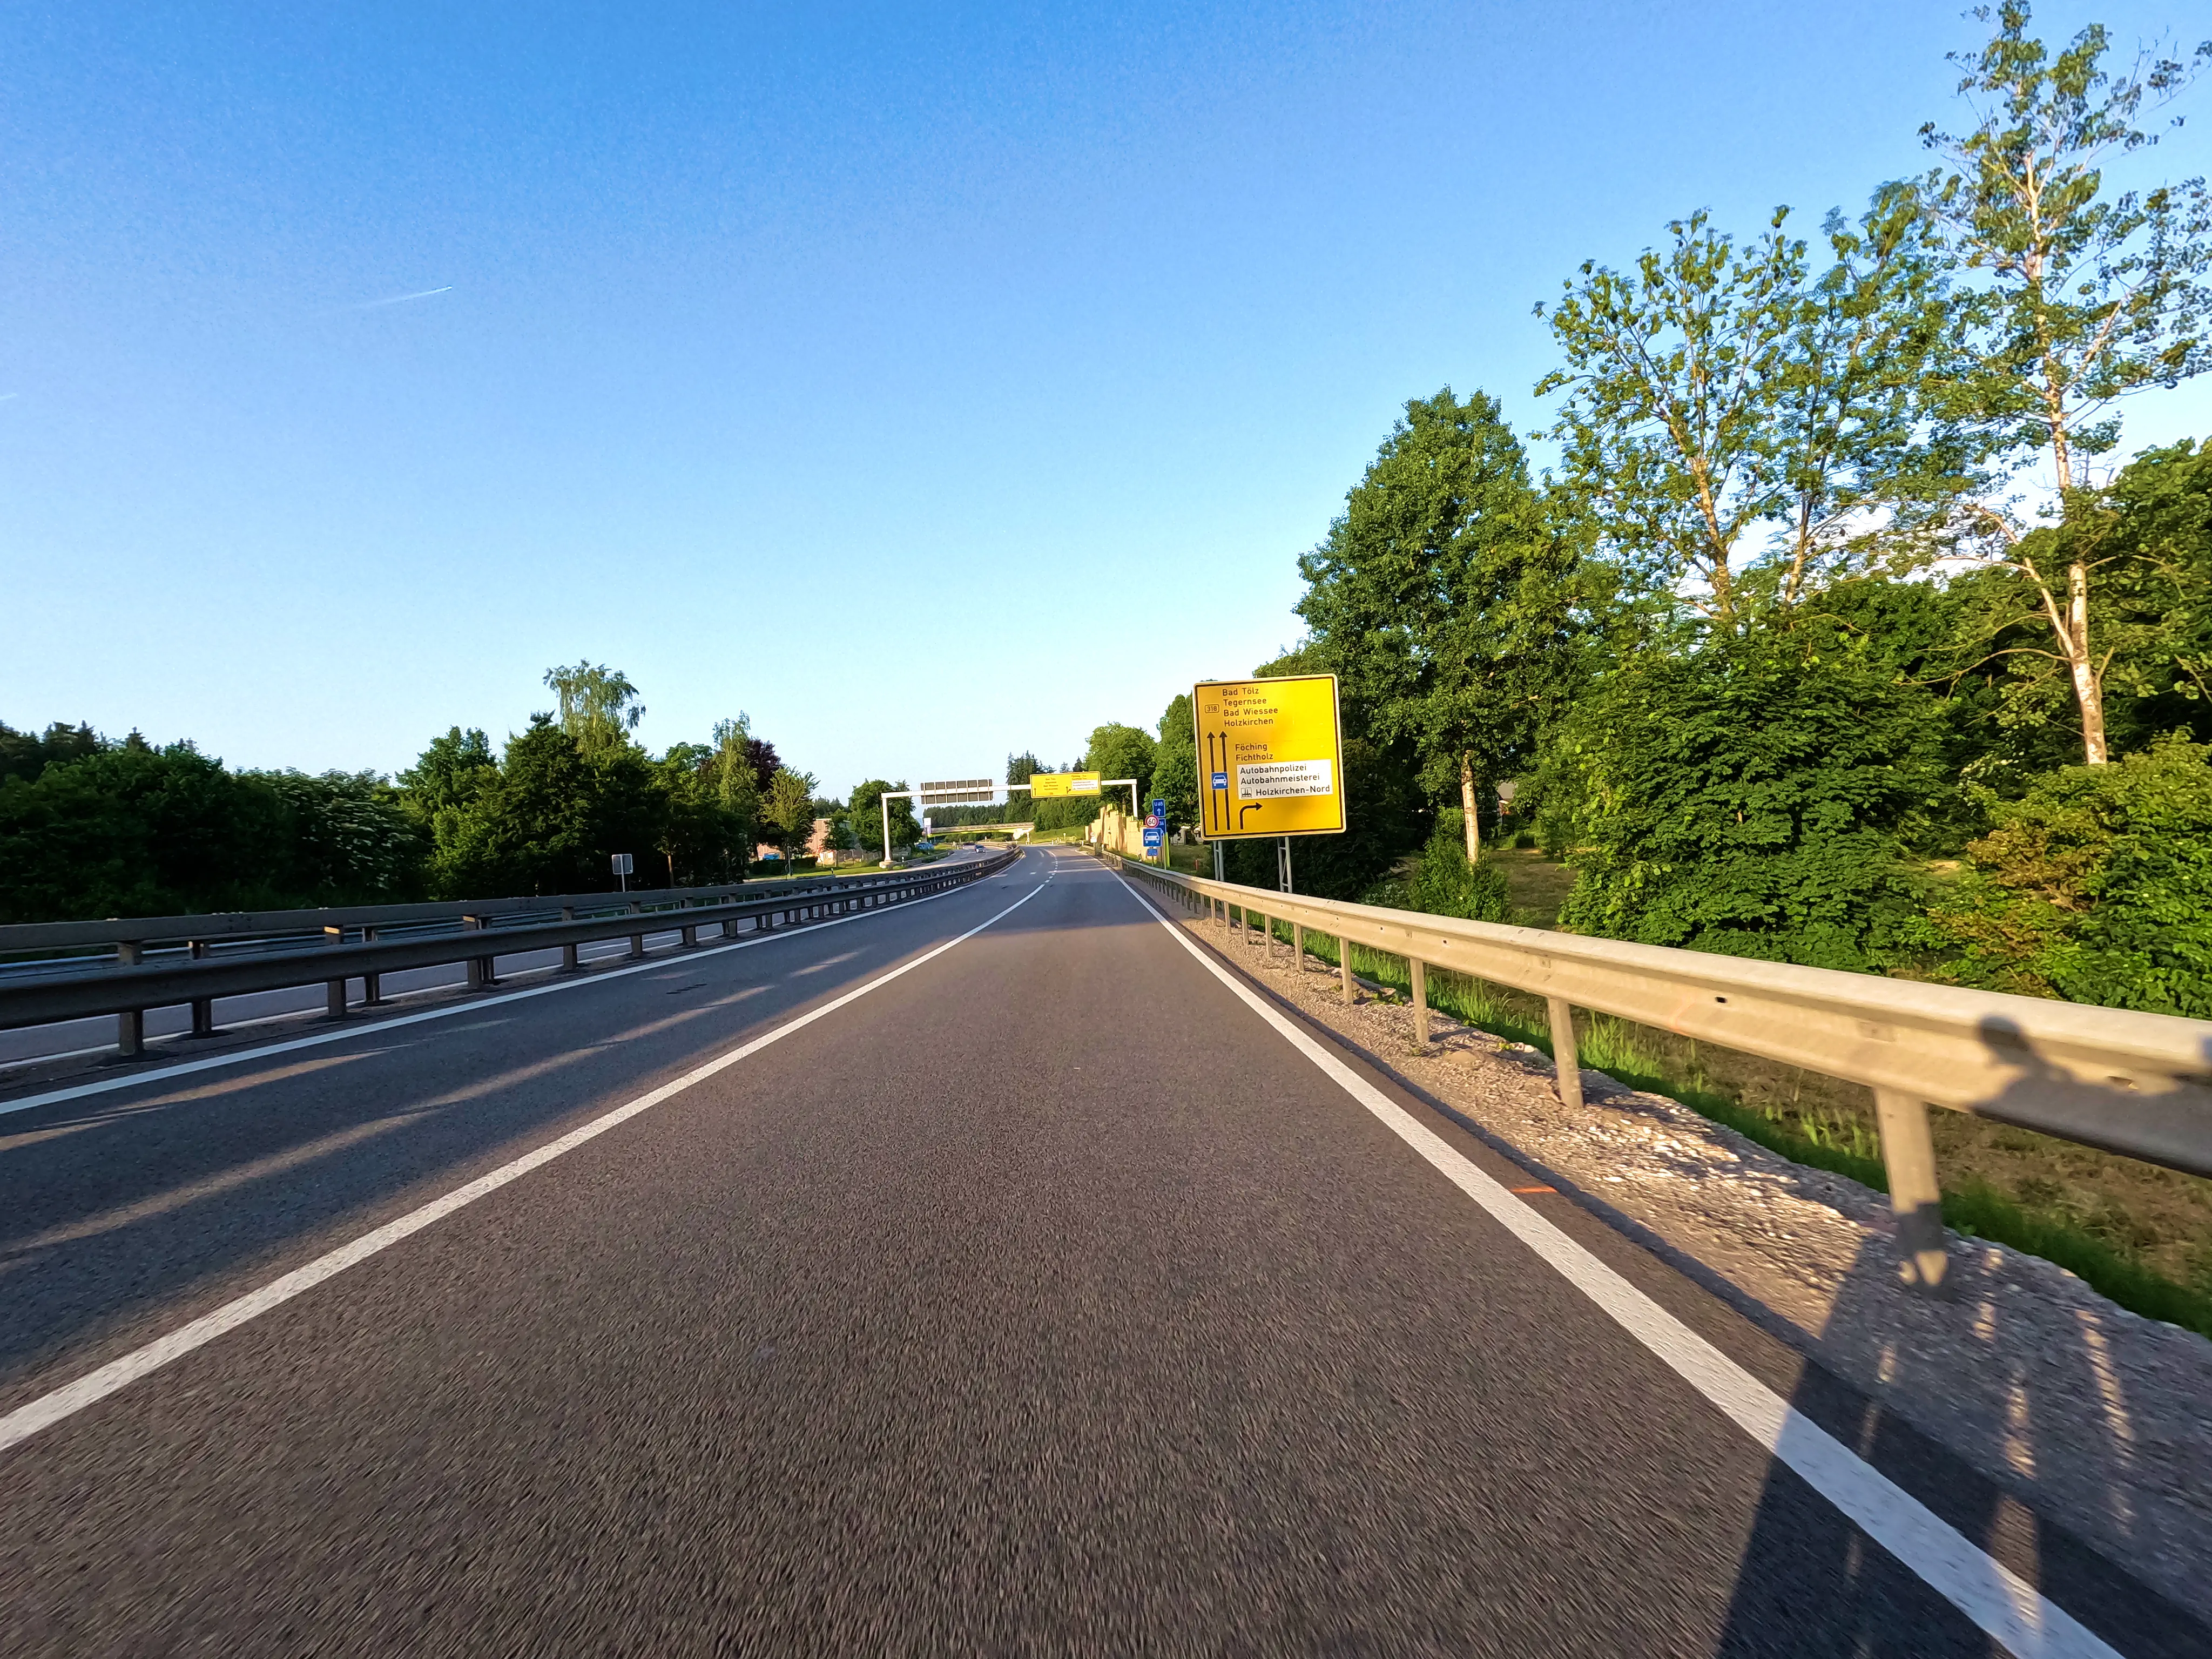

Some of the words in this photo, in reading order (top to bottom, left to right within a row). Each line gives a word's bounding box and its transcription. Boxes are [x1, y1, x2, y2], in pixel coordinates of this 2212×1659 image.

[1223, 698, 1267, 707] Tegernsee
[1243, 707, 1278, 716] Wiessee
[1224, 718, 1273, 727] Holzkirchen
[1235, 743, 1267, 751] Föching
[1236, 753, 1273, 761] Fichtholz
[1240, 764, 1307, 774] Autobahnpolizei
[1240, 773, 1320, 785] Autobahnmeisterei
[1256, 785, 1330, 796] Holzkirchen-Nord
